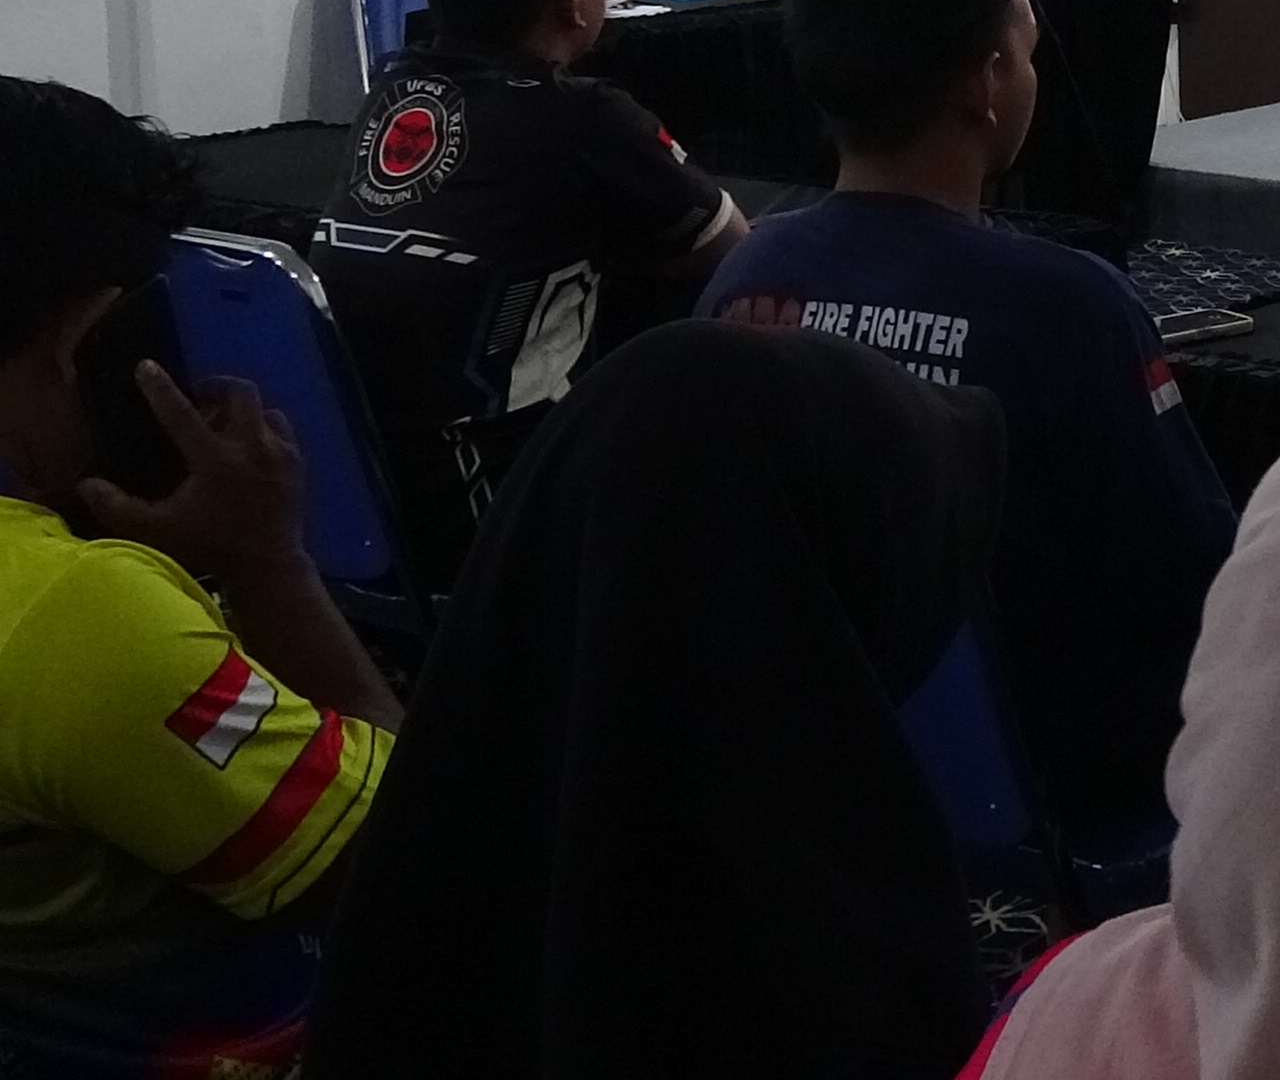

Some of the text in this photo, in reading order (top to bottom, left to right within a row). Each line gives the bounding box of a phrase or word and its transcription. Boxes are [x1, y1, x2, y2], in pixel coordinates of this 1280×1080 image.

[358, 118, 380, 156] FIRE
[430, 112, 462, 182] RESCUE
[801, 301, 854, 337] FIRE
[854, 305, 969, 358] FIGHTER
